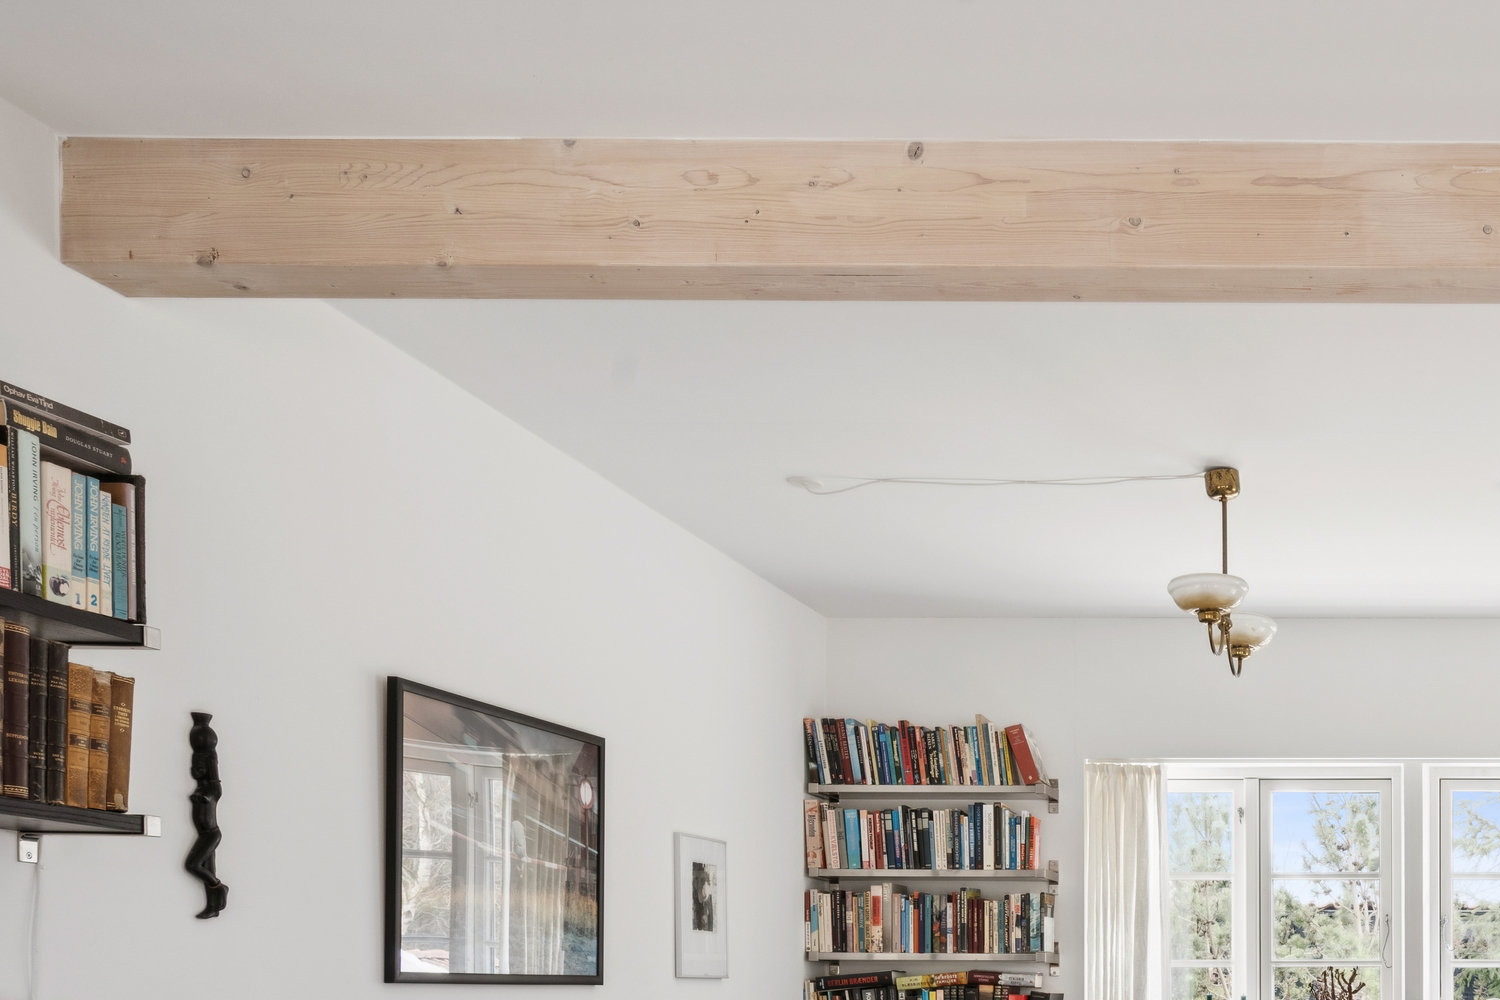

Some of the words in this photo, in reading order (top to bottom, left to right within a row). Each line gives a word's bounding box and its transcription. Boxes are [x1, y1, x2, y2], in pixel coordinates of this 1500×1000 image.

[4, 384, 25, 399] Ophav
[27, 393, 39, 404] Eva
[39, 398, 54, 410] Tind
[13, 409, 41, 432] Shuggie
[42, 420, 57, 439] Bain
[65, 435, 91, 450] DOUGLAS
[92, 446, 113, 458] STUART
[75, 479, 83, 513] JOHN
[90, 480, 99, 514] JOHN
[74, 513, 83, 551] IRVING
[89, 514, 98, 552] IRVING
[103, 565, 111, 589] LIVET
[75, 593, 81, 605] 1
[90, 594, 98, 607] 2
[827, 978, 849, 986] BERLIN
[849, 975, 878, 985] BRÆNDER
